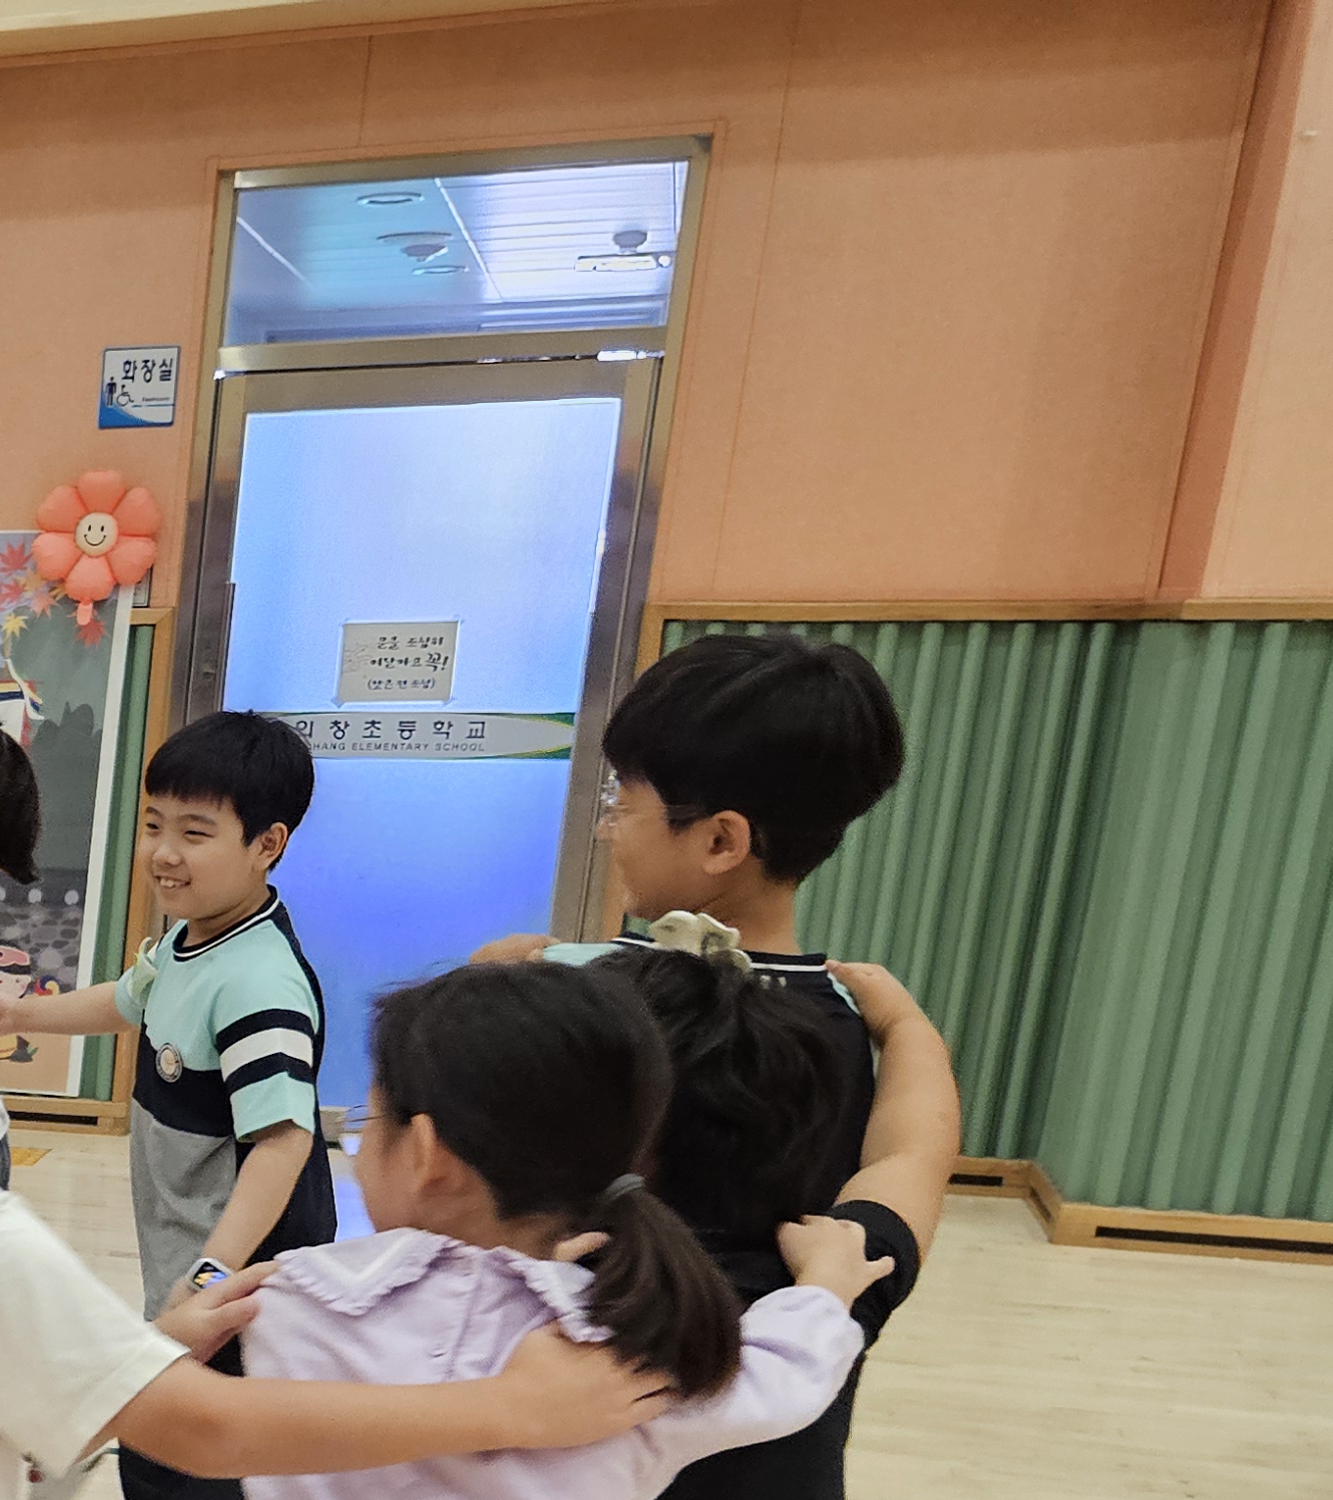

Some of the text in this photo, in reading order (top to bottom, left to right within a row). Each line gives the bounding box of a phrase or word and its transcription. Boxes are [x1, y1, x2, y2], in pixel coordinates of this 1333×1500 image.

[121, 358, 173, 383] 화장실
[406, 636, 444, 650] 조심히
[425, 652, 450, 673] 꼭!
[296, 720, 486, 740] 의창초등학교
[312, 742, 485, 752] HANG ELEMENTARY SCHOOL
